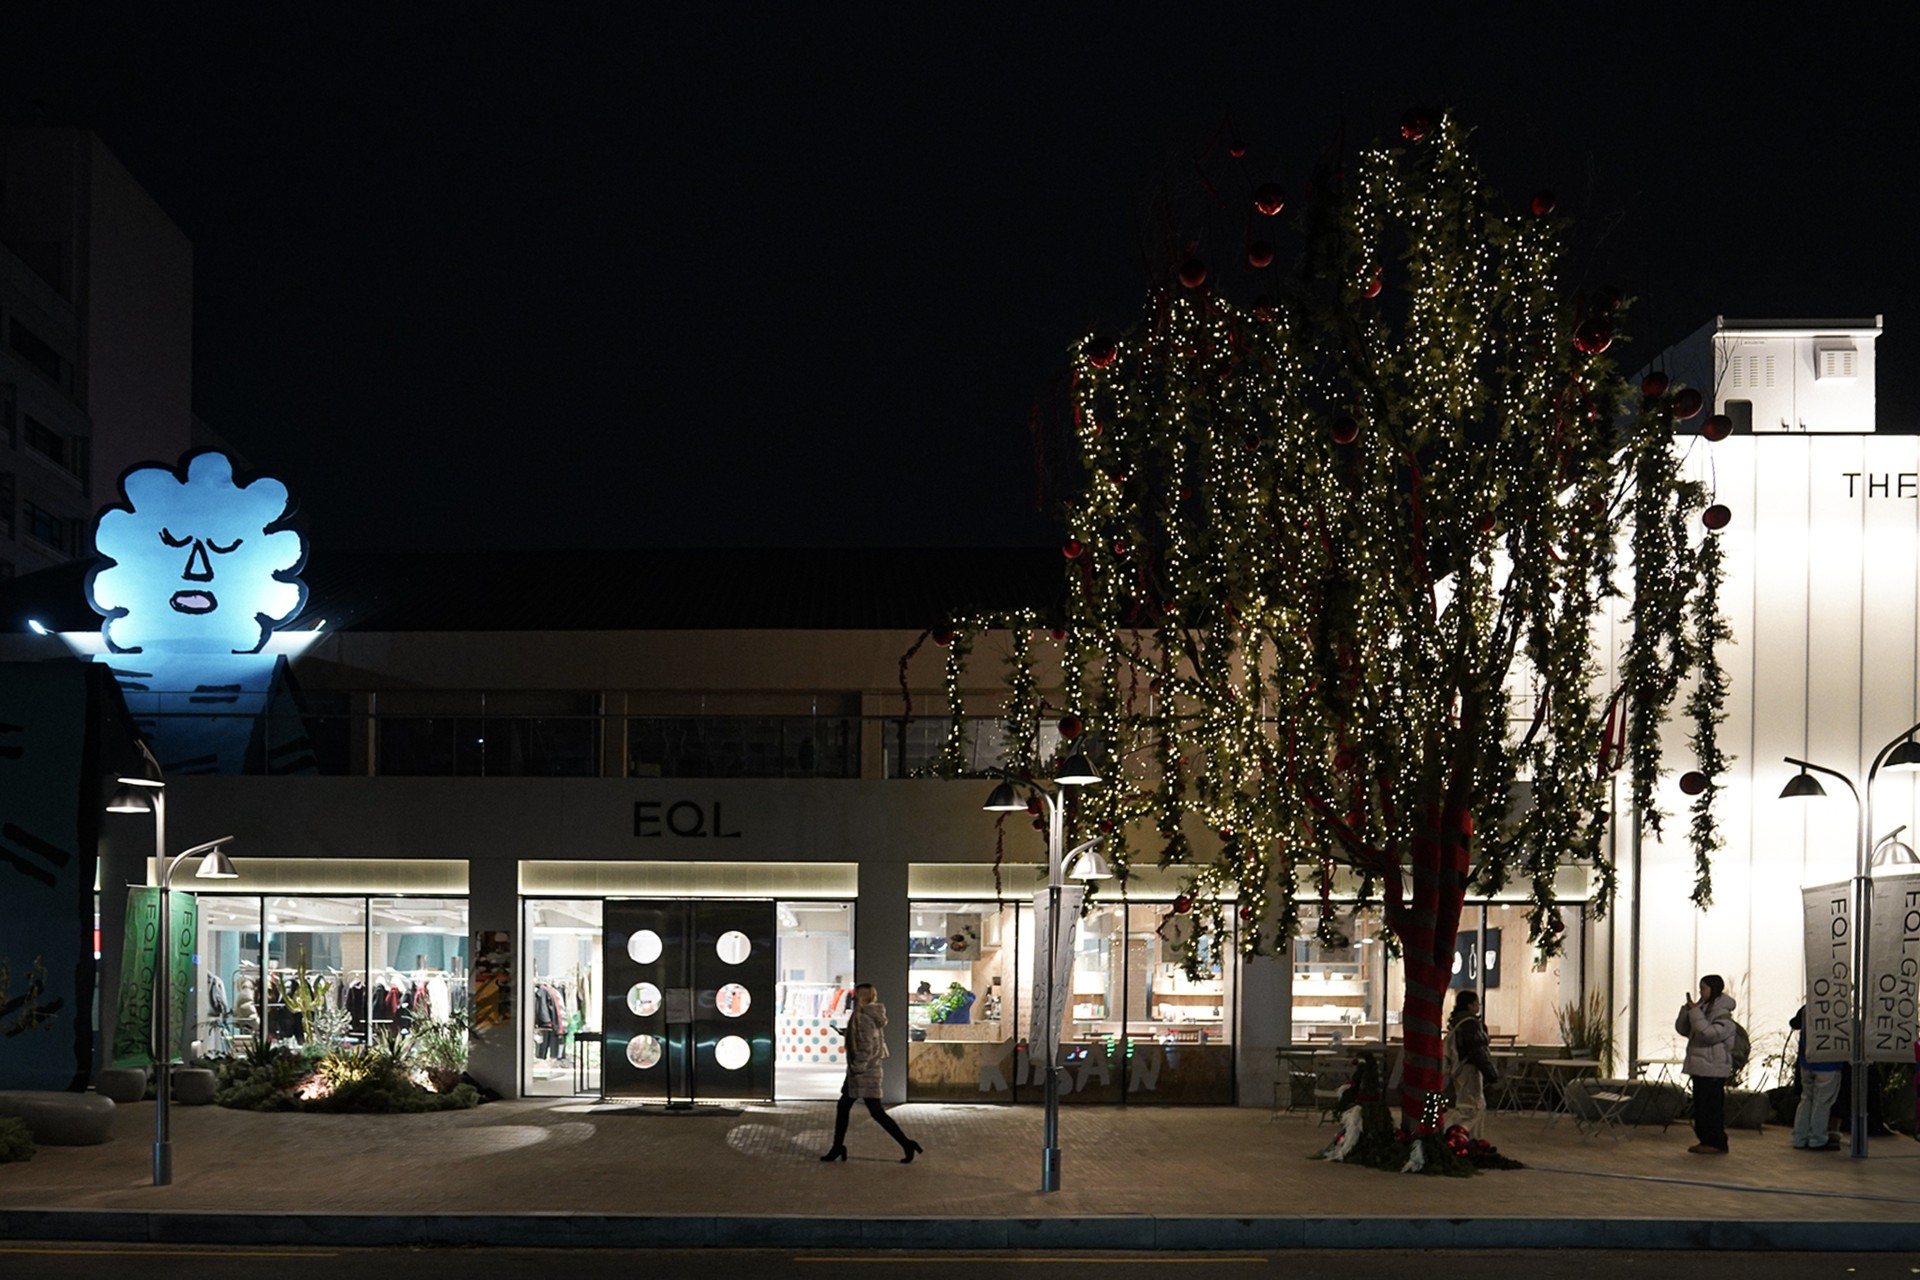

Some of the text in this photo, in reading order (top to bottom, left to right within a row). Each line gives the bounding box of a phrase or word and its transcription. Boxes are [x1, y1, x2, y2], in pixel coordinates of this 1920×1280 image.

[1842, 473, 1919, 498] THE
[634, 801, 742, 837] EQL
[1903, 890, 1920, 954] EQL
[1831, 898, 1850, 1051] EQL GROVE
[1814, 978, 1831, 1051] OPEN
[1877, 974, 1897, 1050] OPEN
